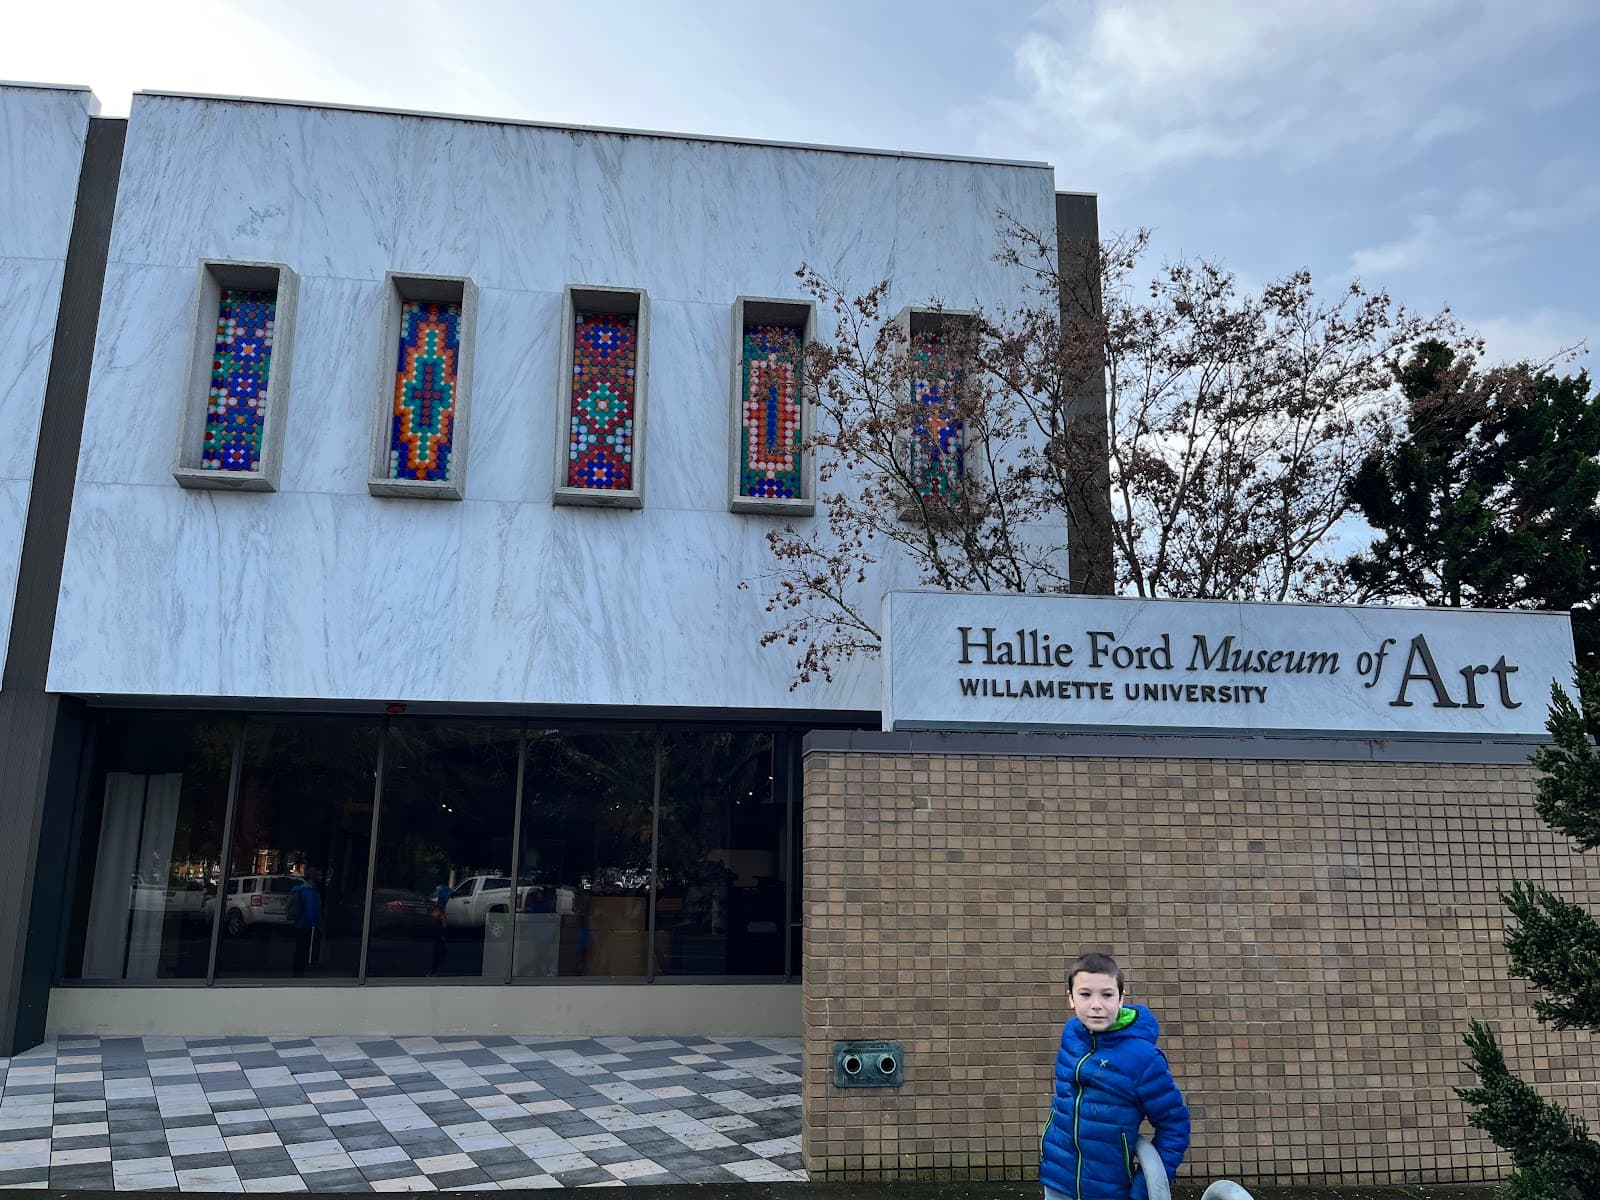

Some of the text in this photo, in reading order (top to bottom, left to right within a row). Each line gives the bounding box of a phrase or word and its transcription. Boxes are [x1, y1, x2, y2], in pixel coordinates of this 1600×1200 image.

[957, 626, 1523, 710] Hallie Ford Museum of Art
[959, 677, 1269, 705] WILLAMETTE UNIVERSITY
